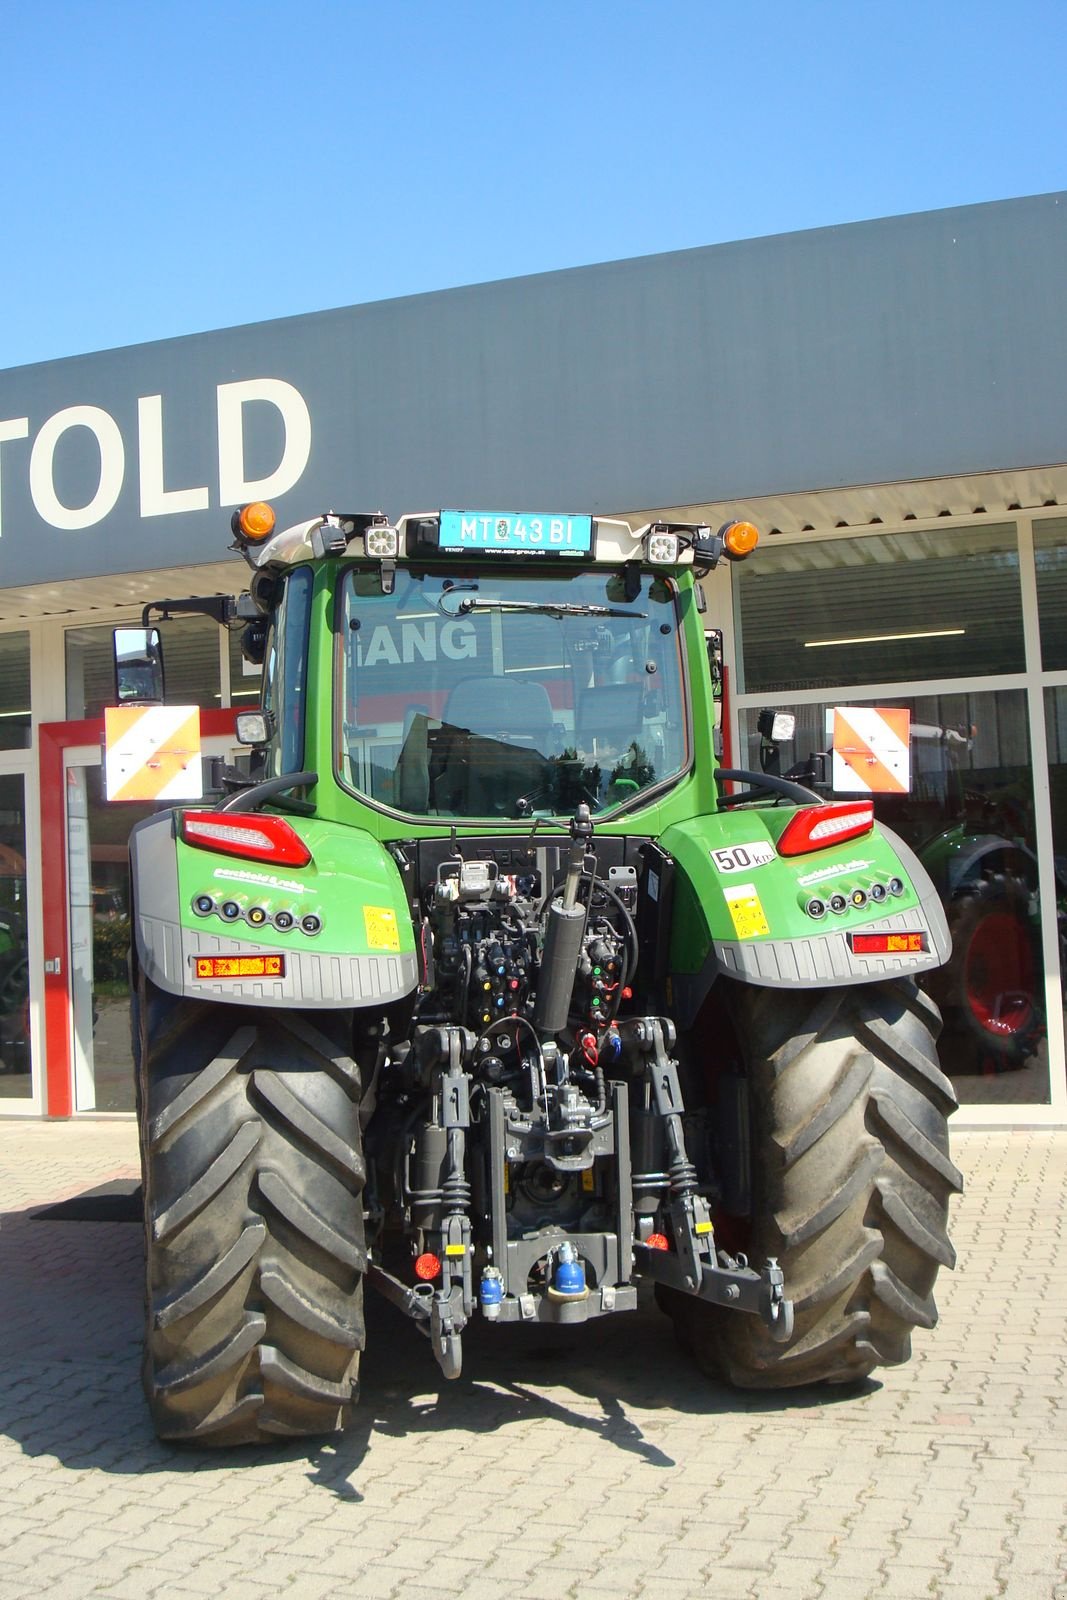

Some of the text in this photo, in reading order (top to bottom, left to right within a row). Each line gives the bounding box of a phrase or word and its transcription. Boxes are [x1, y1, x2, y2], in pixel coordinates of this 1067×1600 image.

[460, 517, 491, 542] MT
[513, 519, 543, 544] 43
[715, 847, 752, 871] 50
